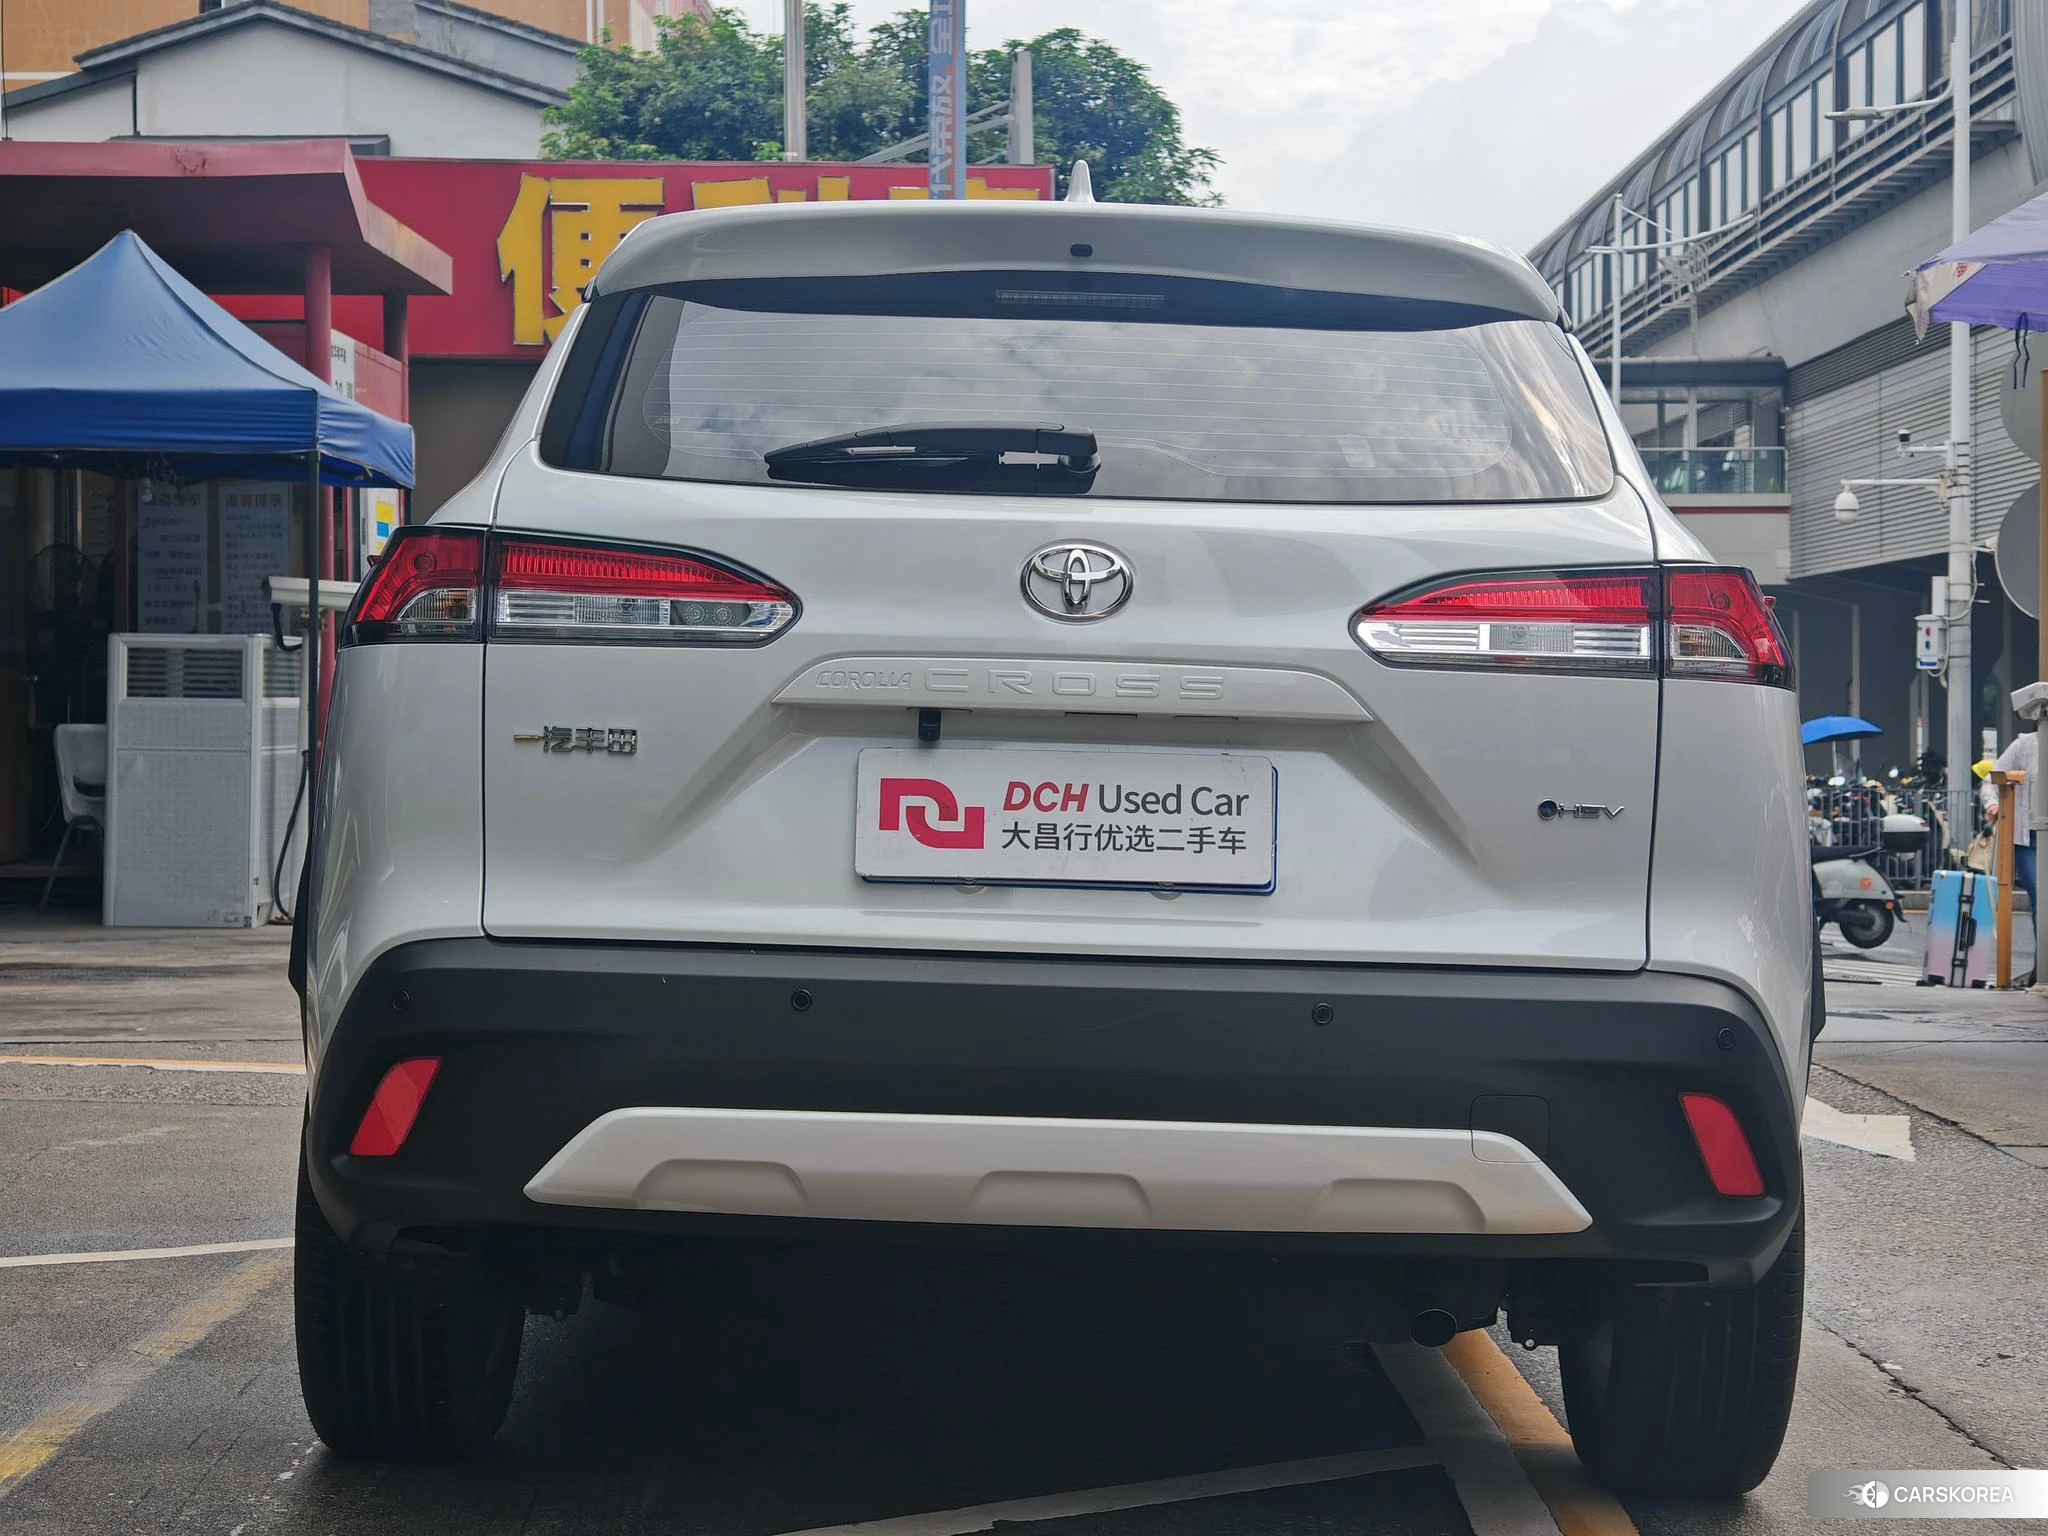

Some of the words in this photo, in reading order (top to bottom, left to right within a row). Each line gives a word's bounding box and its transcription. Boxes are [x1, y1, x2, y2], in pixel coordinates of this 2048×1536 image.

[816, 670, 912, 690] COROLLA
[924, 668, 1224, 700] CROSS
[1002, 781, 1089, 812] DCH
[1098, 784, 1182, 815] Used
[1191, 786, 1250, 817] Car
[1558, 802, 1625, 819] HEV
[1001, 821, 1248, 855] 大昌行优选二手车
